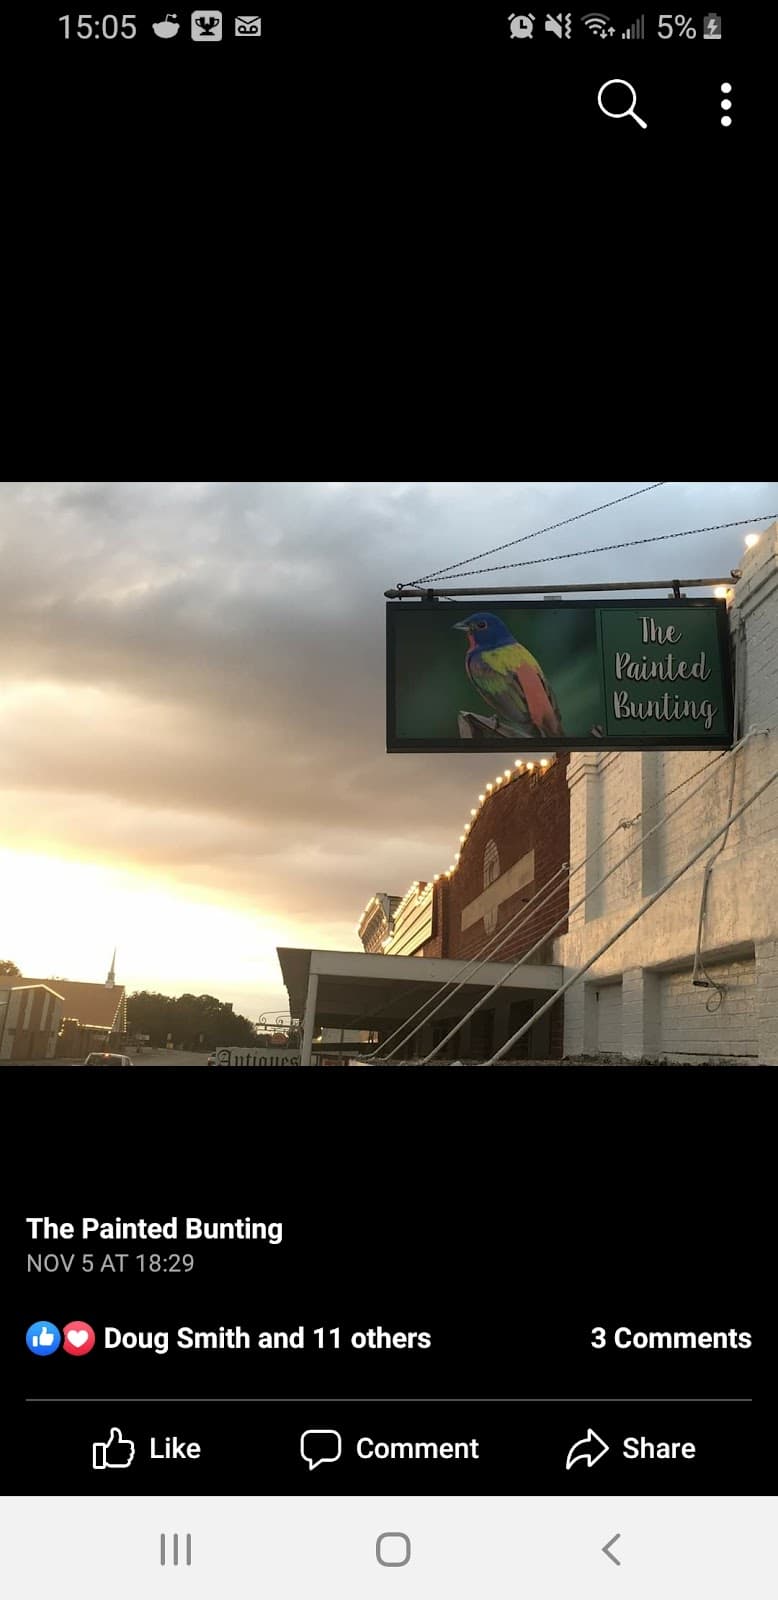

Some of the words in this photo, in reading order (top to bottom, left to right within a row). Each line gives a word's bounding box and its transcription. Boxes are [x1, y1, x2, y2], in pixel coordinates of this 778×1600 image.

[639, 616, 682, 645] The
[614, 651, 712, 681] Painted
[613, 690, 717, 729] Bunting
